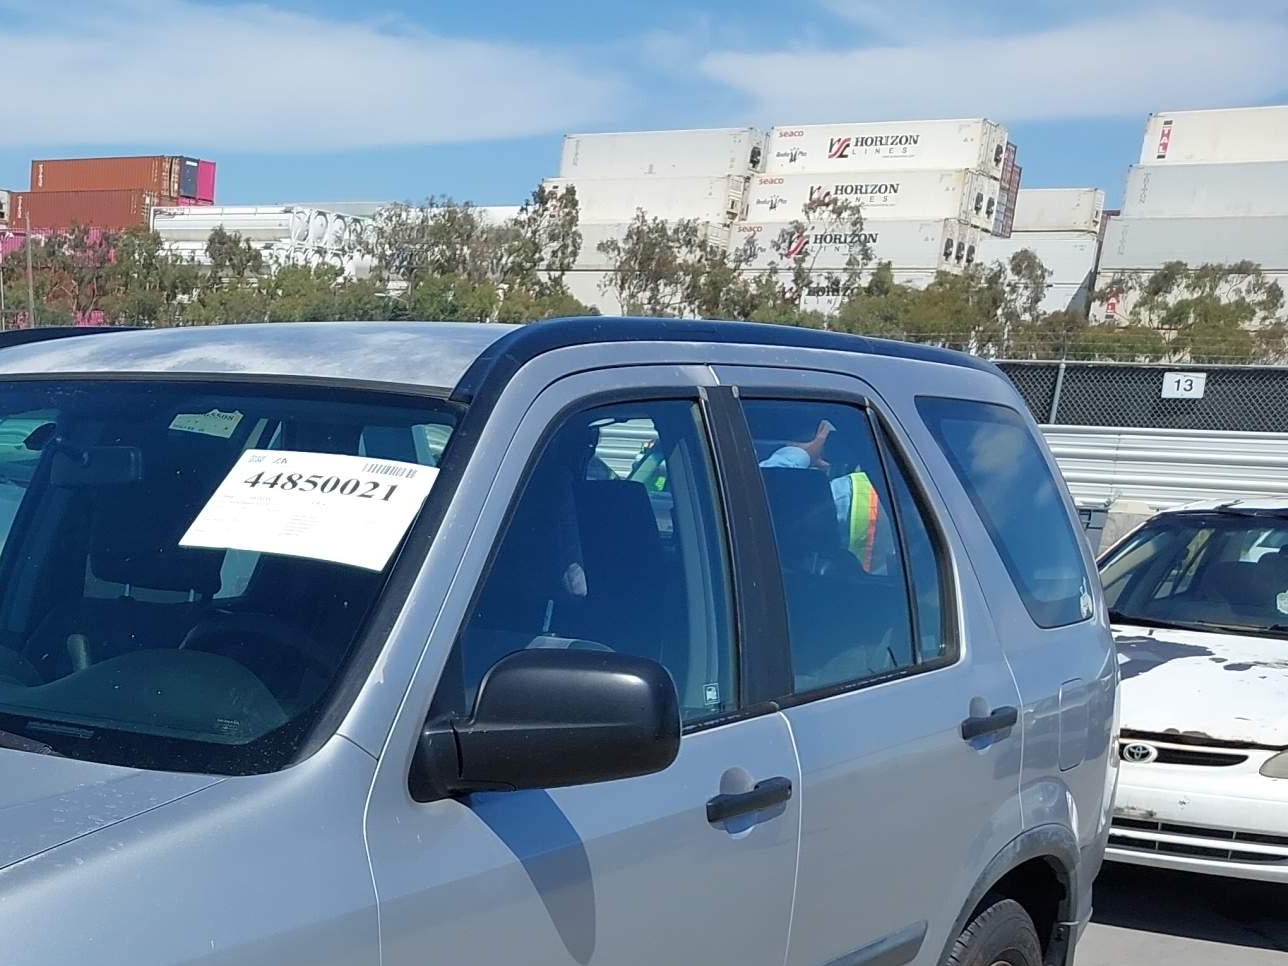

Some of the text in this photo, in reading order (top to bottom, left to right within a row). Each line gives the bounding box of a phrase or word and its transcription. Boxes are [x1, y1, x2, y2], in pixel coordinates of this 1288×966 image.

[778, 129, 804, 138] seaco
[854, 134, 920, 148] HORIZON
[852, 147, 908, 155] LINES
[758, 176, 785, 185] seaco
[833, 183, 900, 196] HORIZON
[813, 233, 879, 244] HORIZON
[1174, 378, 1194, 392] 13
[243, 471, 399, 502] 44850021
